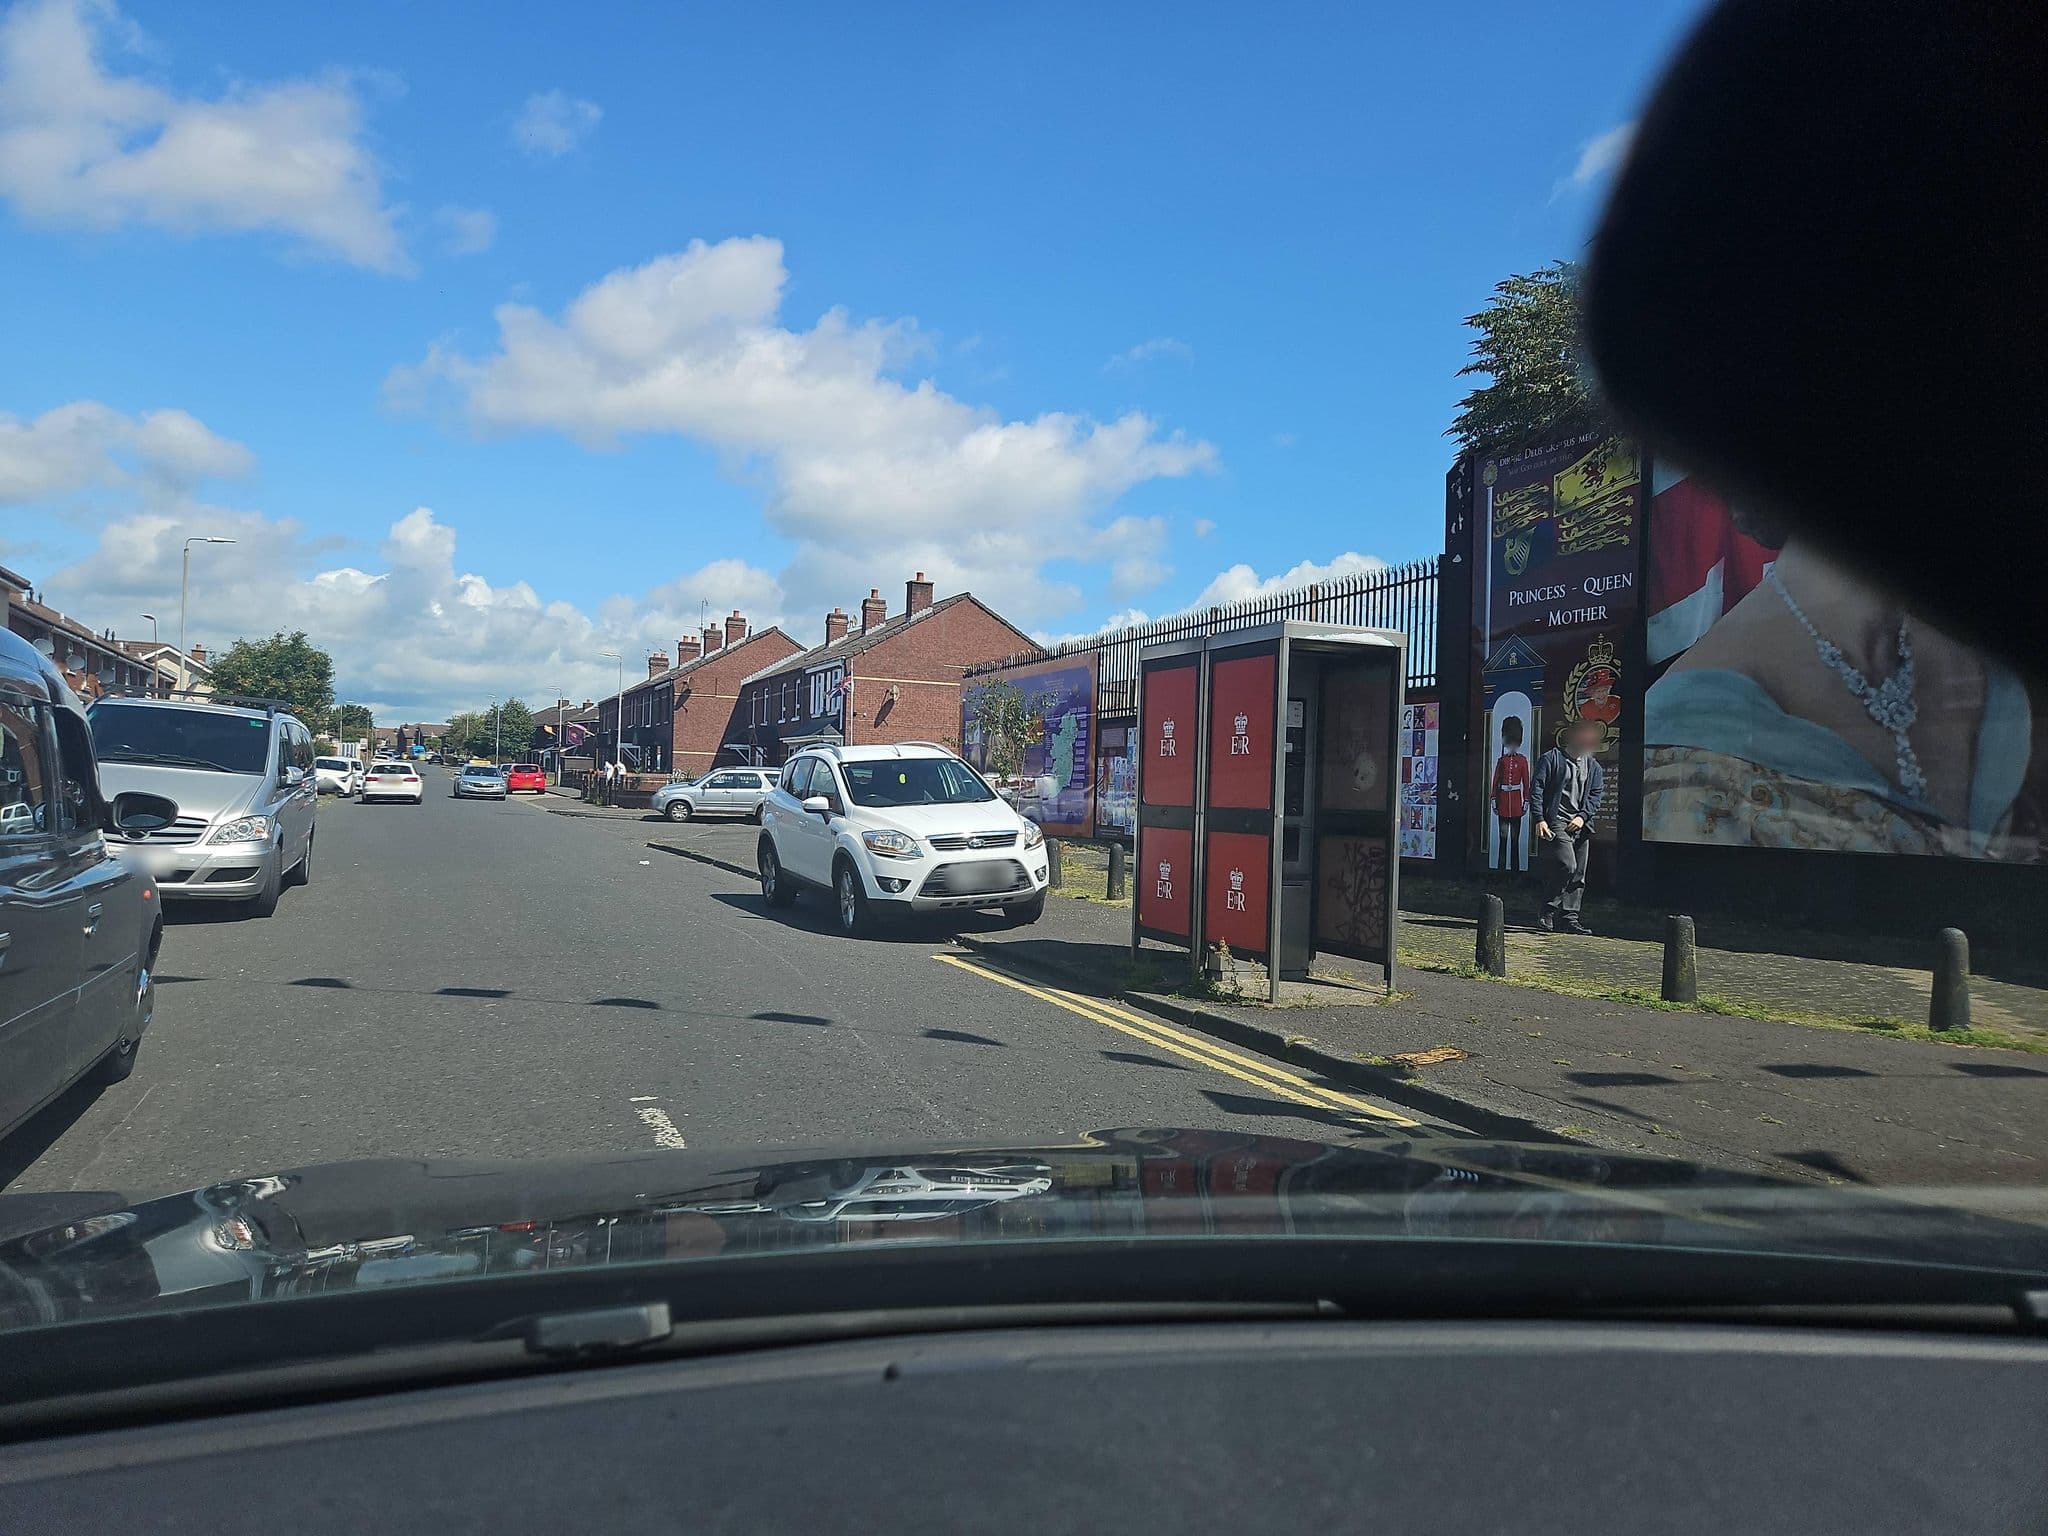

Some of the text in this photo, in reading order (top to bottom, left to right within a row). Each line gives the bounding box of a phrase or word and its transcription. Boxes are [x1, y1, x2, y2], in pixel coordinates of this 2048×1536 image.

[1508, 584, 1566, 606] PRINCESS
[1583, 572, 1633, 596] QUEEN
[1548, 605, 1608, 627] MOTHER
